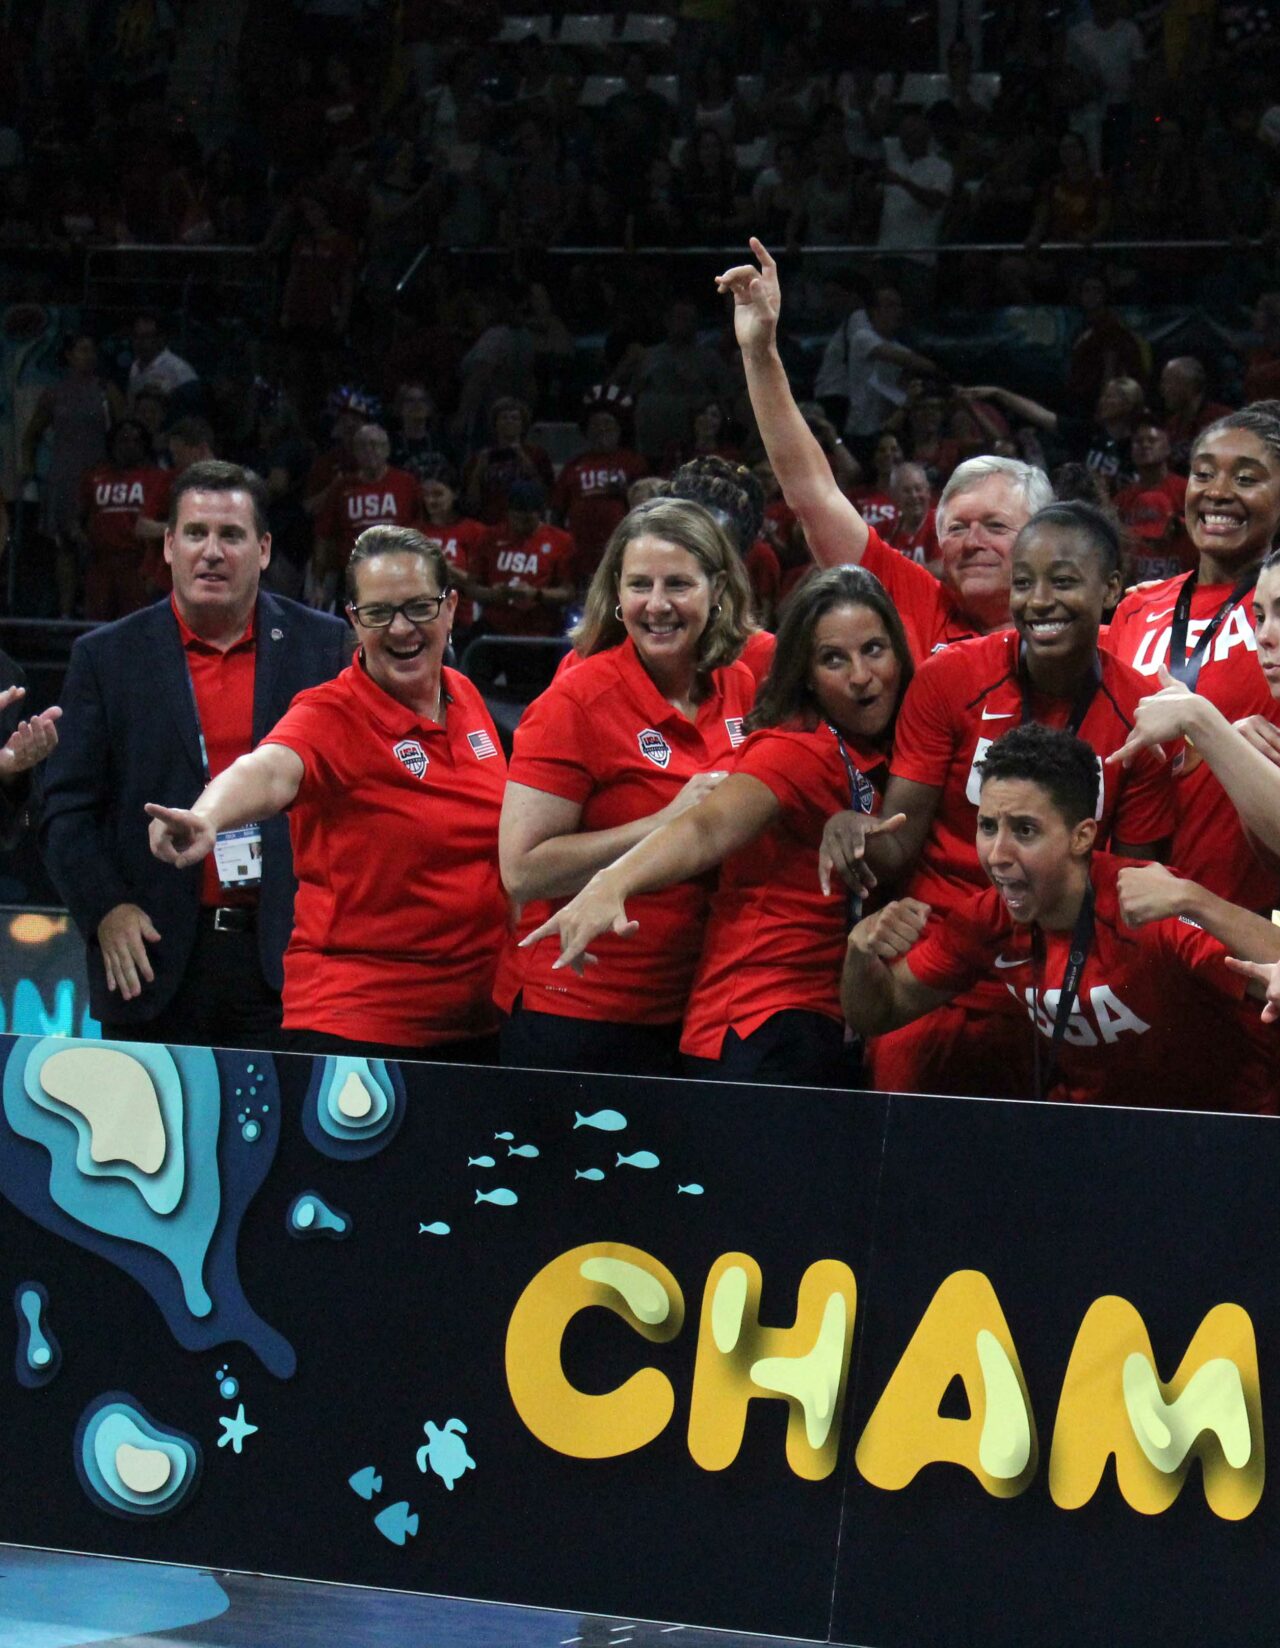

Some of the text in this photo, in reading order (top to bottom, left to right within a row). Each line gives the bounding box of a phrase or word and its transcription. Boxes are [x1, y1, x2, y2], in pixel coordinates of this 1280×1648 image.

[96, 481, 145, 506] USA
[347, 492, 397, 519] USA
[497, 551, 539, 575] USA
